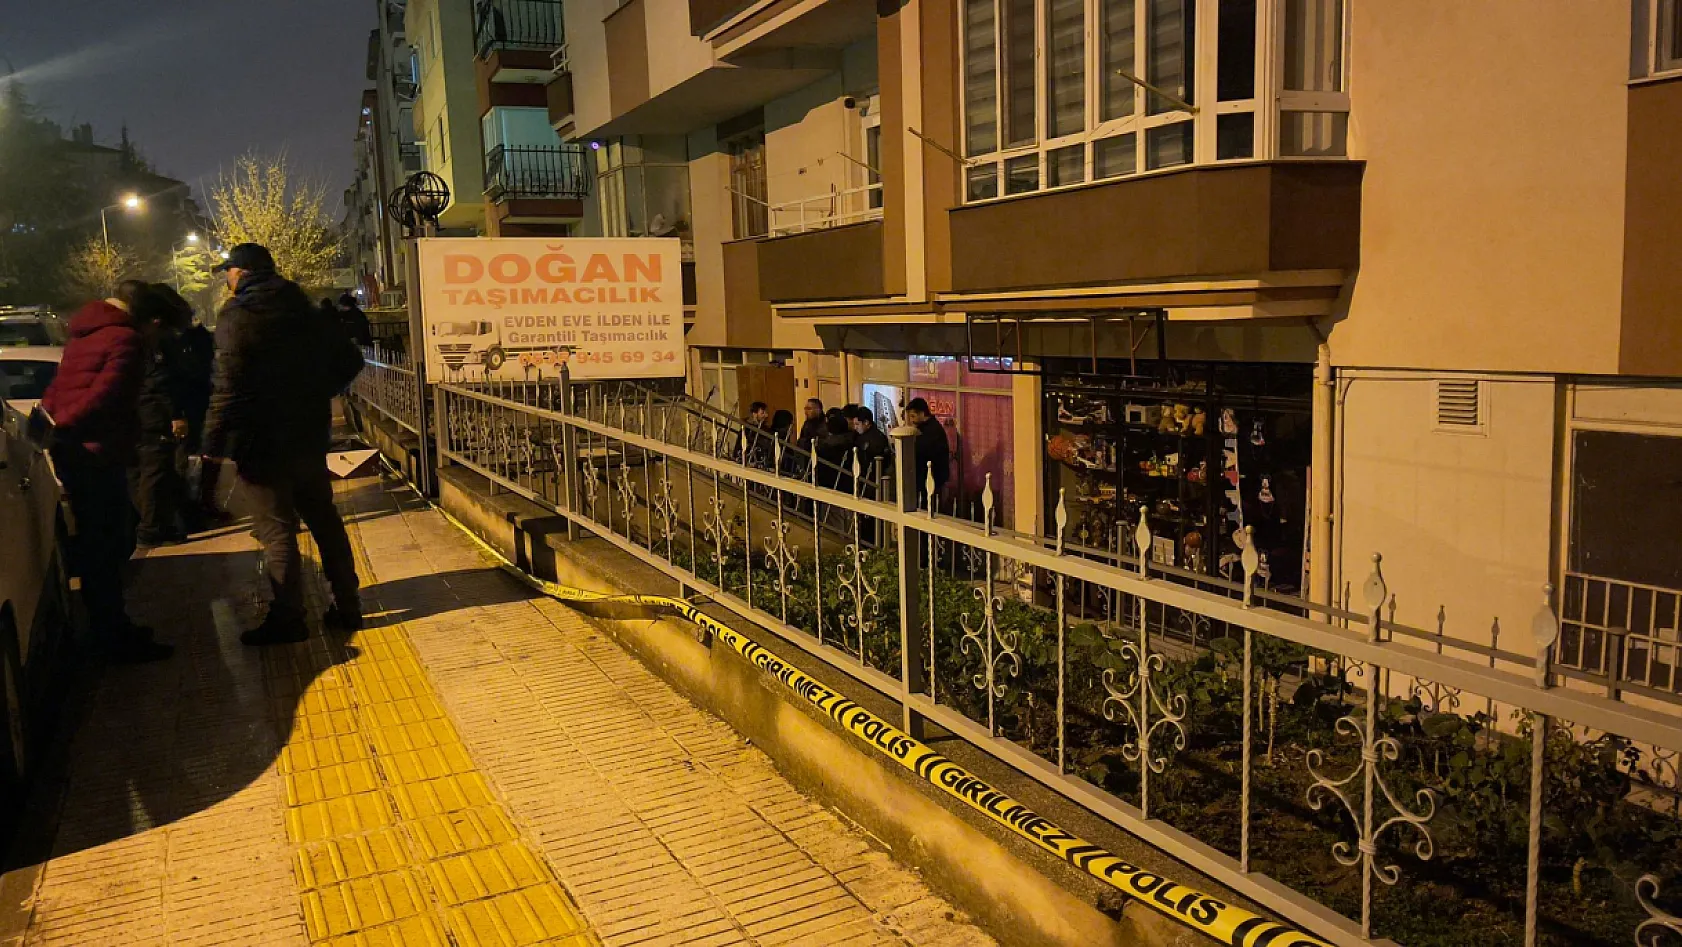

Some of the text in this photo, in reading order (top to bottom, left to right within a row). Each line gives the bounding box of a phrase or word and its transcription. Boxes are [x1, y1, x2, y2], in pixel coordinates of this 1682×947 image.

[443, 244, 662, 284] DOĞAN
[442, 287, 662, 309] TAŞIMACILIK
[504, 311, 671, 328] EVDEN EVE İLDEN İLE
[508, 330, 668, 345] Garantili Taşımacılık
[576, 351, 614, 364] 945
[620, 351, 645, 363] 69
[652, 351, 675, 363] 34
[850, 711, 916, 759] POLİS
[939, 767, 1077, 851] GİRİLMEZ
[1104, 861, 1226, 926] POLİS
